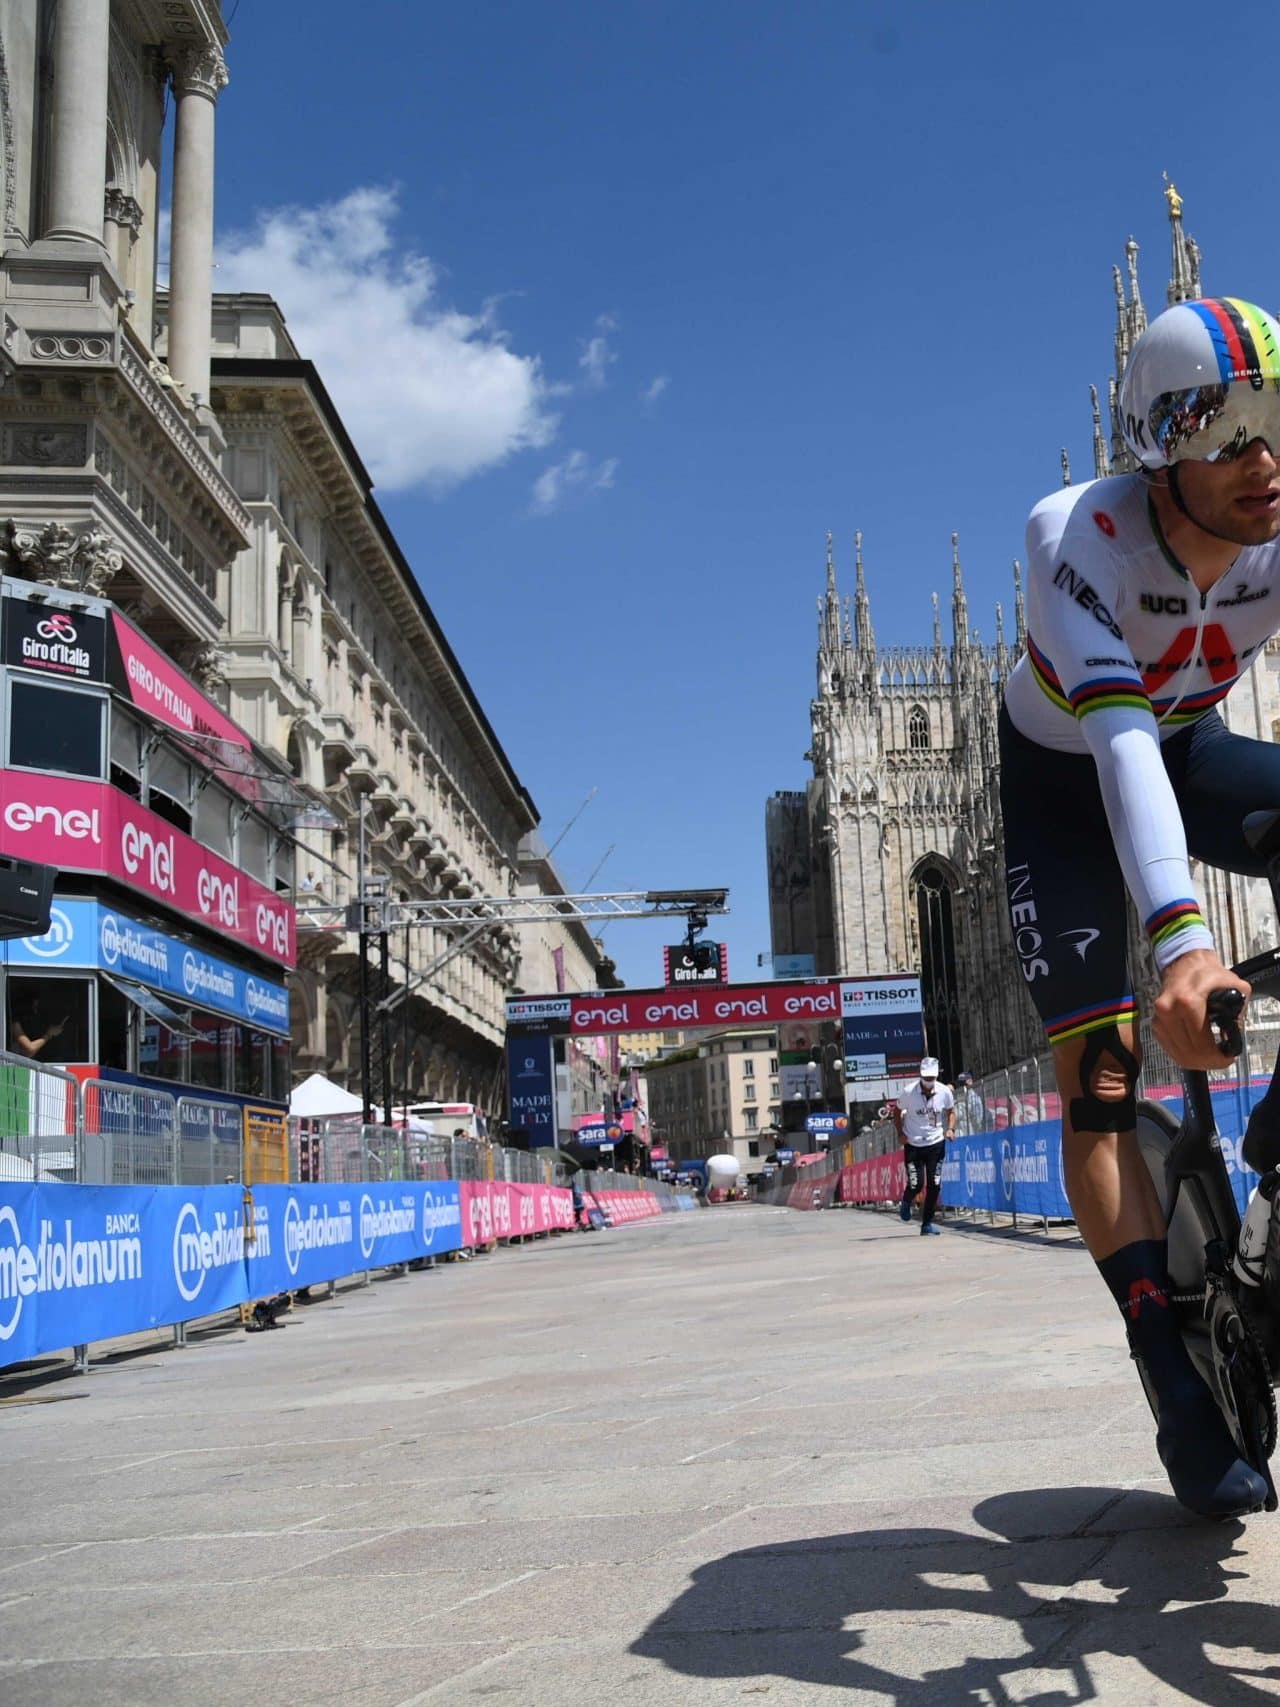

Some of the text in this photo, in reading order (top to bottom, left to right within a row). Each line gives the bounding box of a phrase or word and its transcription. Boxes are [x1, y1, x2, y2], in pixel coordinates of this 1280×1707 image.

[1053, 561, 1124, 641] INEOS
[1149, 594, 1187, 615] UCI
[22, 637, 90, 668] Giro d'Italia
[128, 655, 154, 694] GIRO
[154, 678, 194, 731] D'ITALIA
[4, 802, 101, 844] enel
[122, 822, 290, 956] enel enel enel
[1007, 859, 1050, 983] INEOS
[104, 927, 168, 973] mediolanum
[185, 960, 235, 998] mediolanum
[864, 988, 918, 1001] TISSOT
[527, 1003, 569, 1013] TISSOT
[574, 991, 837, 1027] enel enel enel enel
[512, 1096, 551, 1108] MADE
[578, 1128, 606, 1140] sara
[807, 1117, 834, 1127] sara
[106, 1213, 141, 1235] BANCA
[286, 1203, 353, 1252] mediolanum
[0, 1219, 142, 1299] mediolanum
